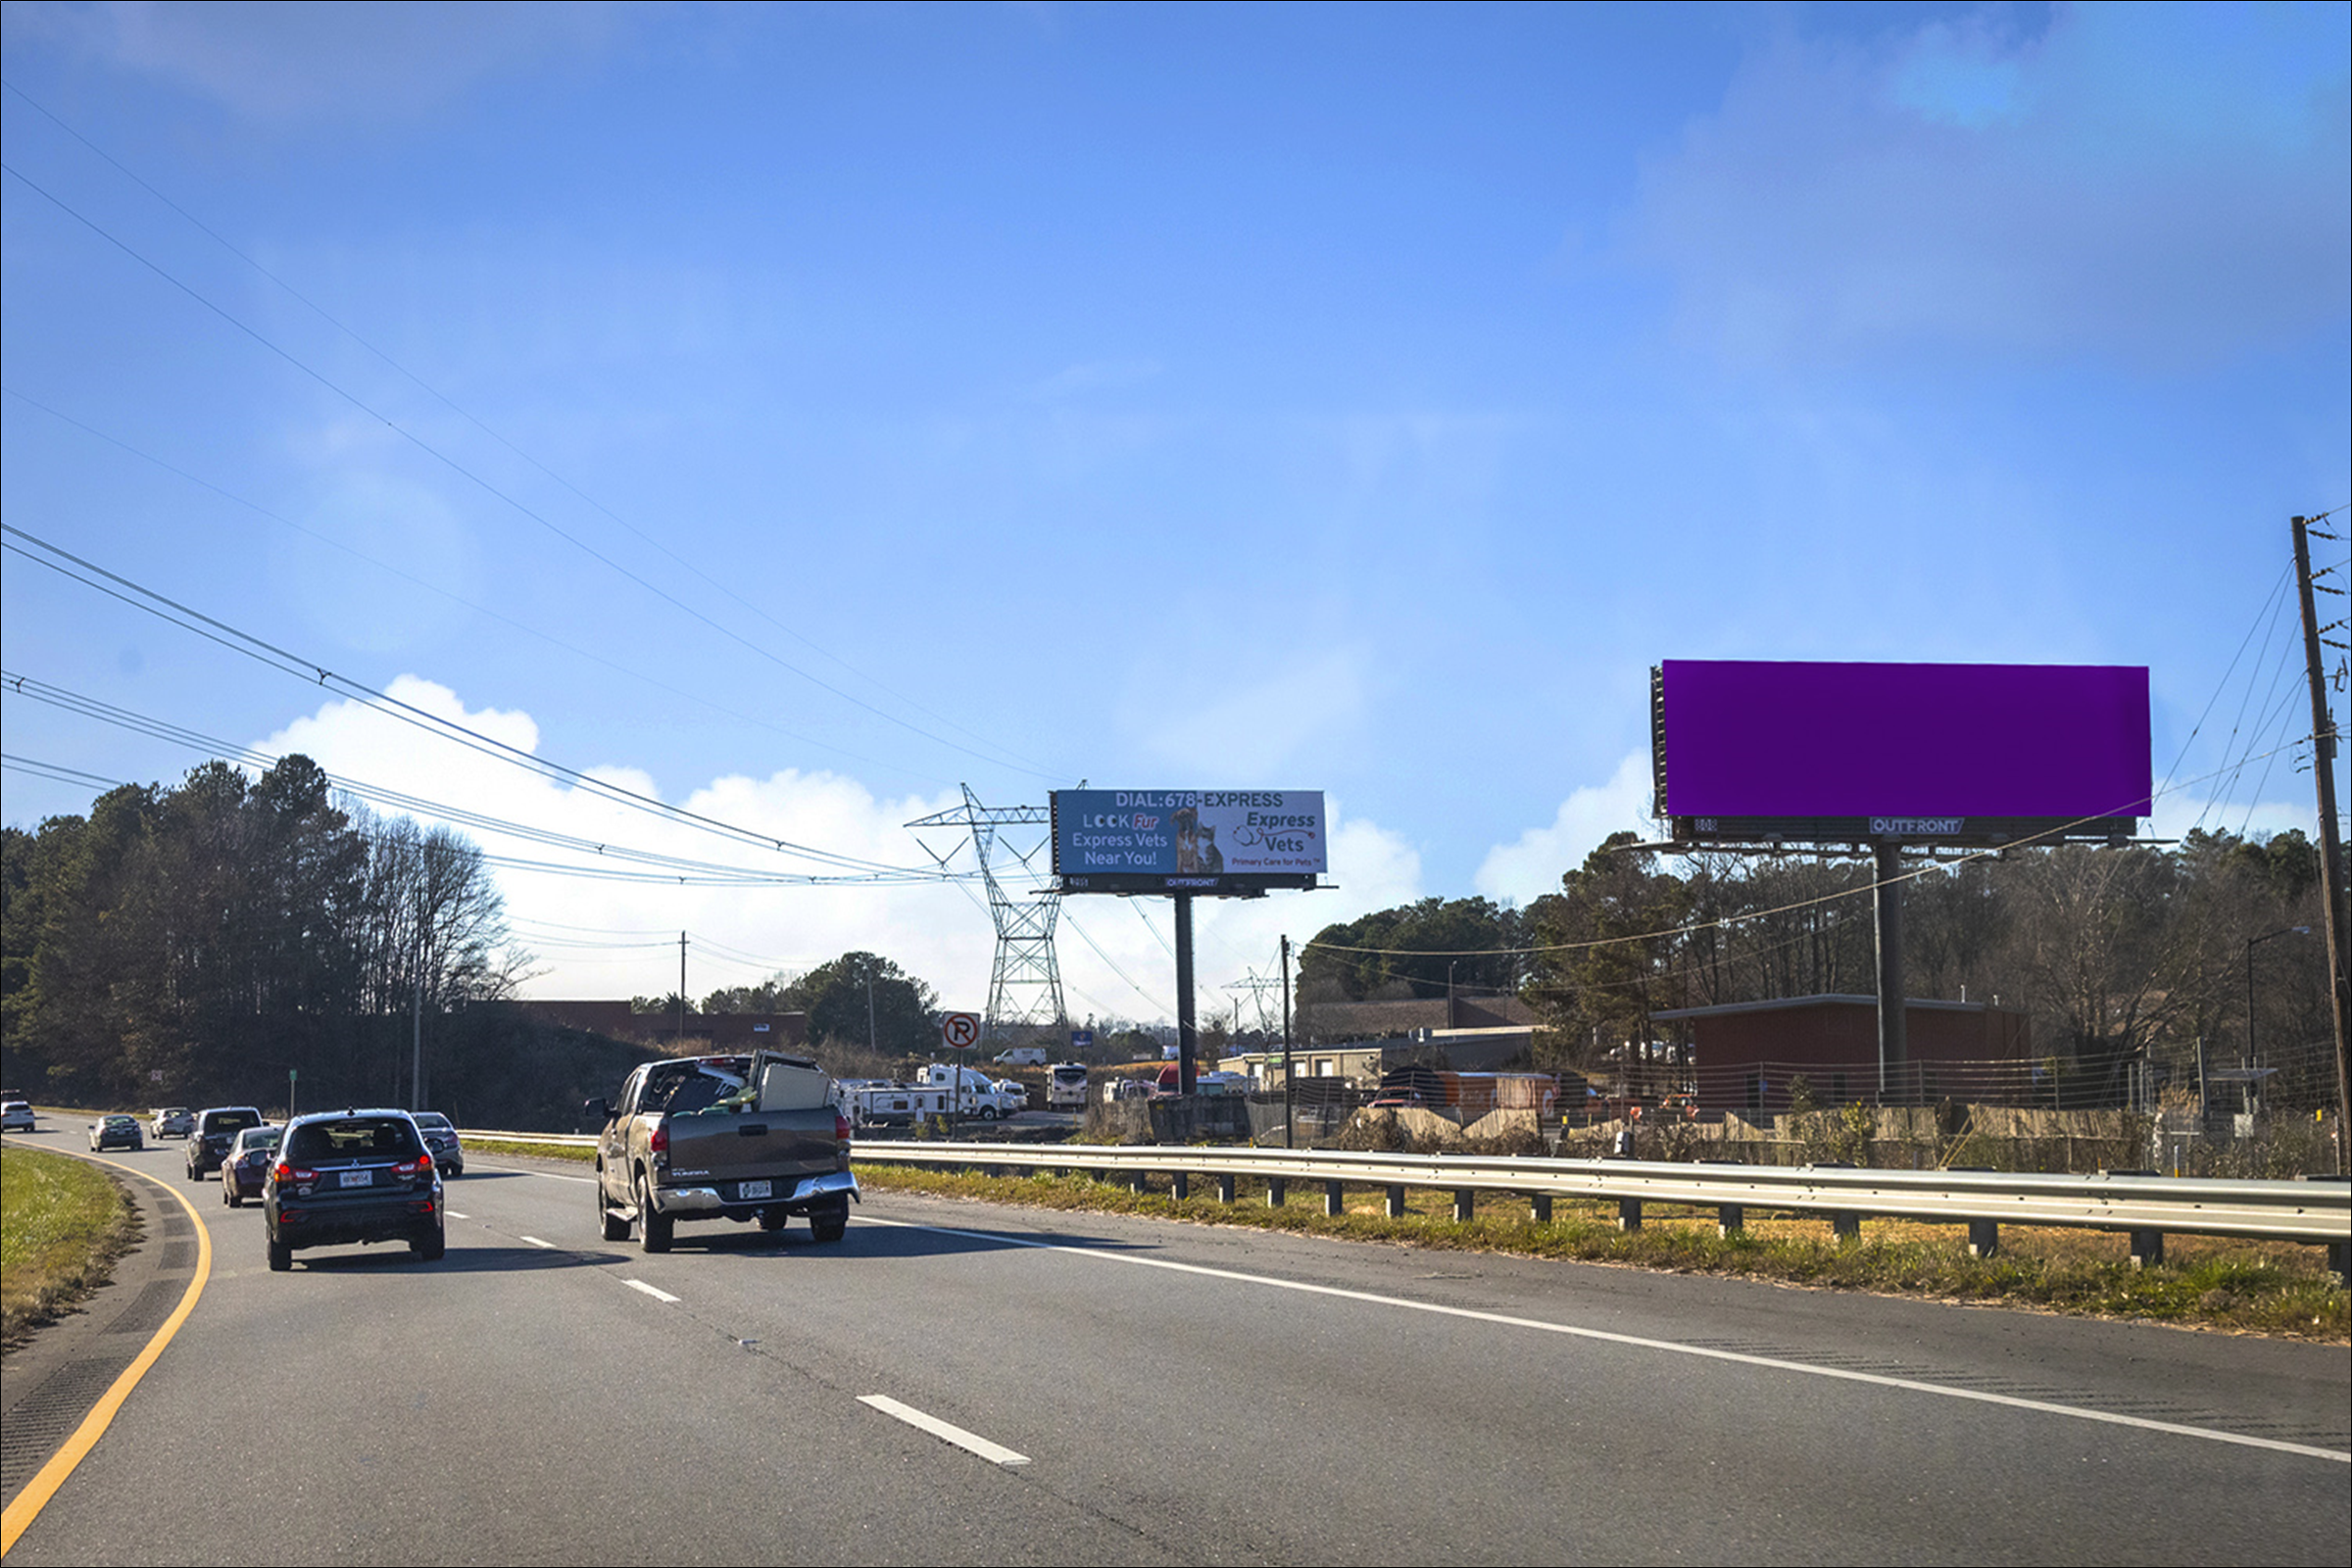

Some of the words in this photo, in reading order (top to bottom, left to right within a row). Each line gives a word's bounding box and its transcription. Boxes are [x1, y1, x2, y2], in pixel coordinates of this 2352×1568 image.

[1116, 792, 1284, 808] DIAL:678-EXPRESS
[1133, 812, 1159, 830] Fur
[1247, 811, 1315, 830] Express
[1874, 819, 1958, 832] OUTFRONT
[1072, 832, 1133, 850] Express
[1134, 832, 1168, 848] Vets
[1264, 836, 1304, 853] Vets
[1084, 851, 1121, 865] Near
[1124, 851, 1157, 866] You!
[1232, 857, 1261, 867] Primary
[1263, 857, 1282, 866] Care
[1283, 857, 1294, 866] for
[1295, 857, 1312, 867] Pets
[1166, 877, 1216, 887] OUTFRONT
[954, 1021, 971, 1041] P
